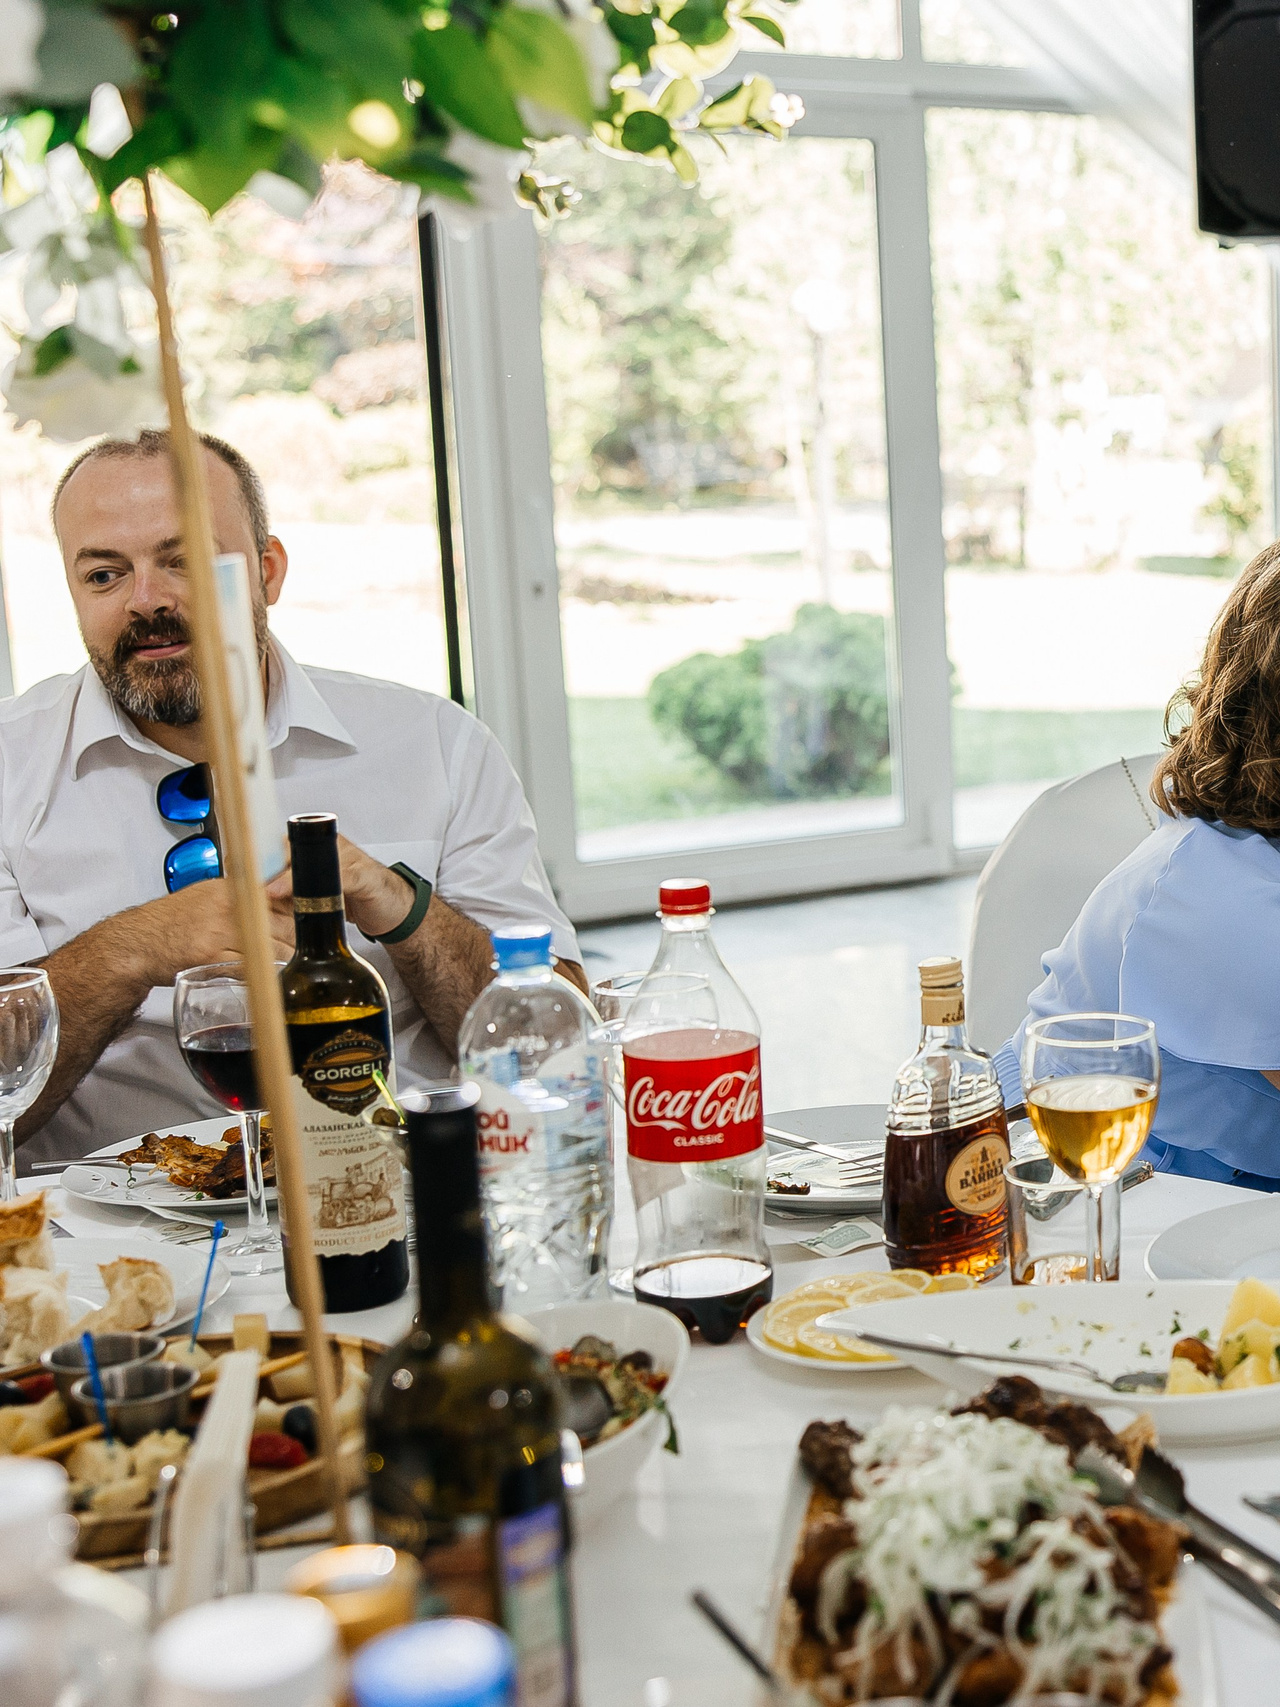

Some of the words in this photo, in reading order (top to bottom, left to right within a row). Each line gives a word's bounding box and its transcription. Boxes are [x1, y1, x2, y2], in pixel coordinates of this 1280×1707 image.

[628, 1065, 759, 1131] Coca-Cola
[673, 1132, 724, 1147] CLASSIC
[313, 1237, 355, 1247] RODUCT
